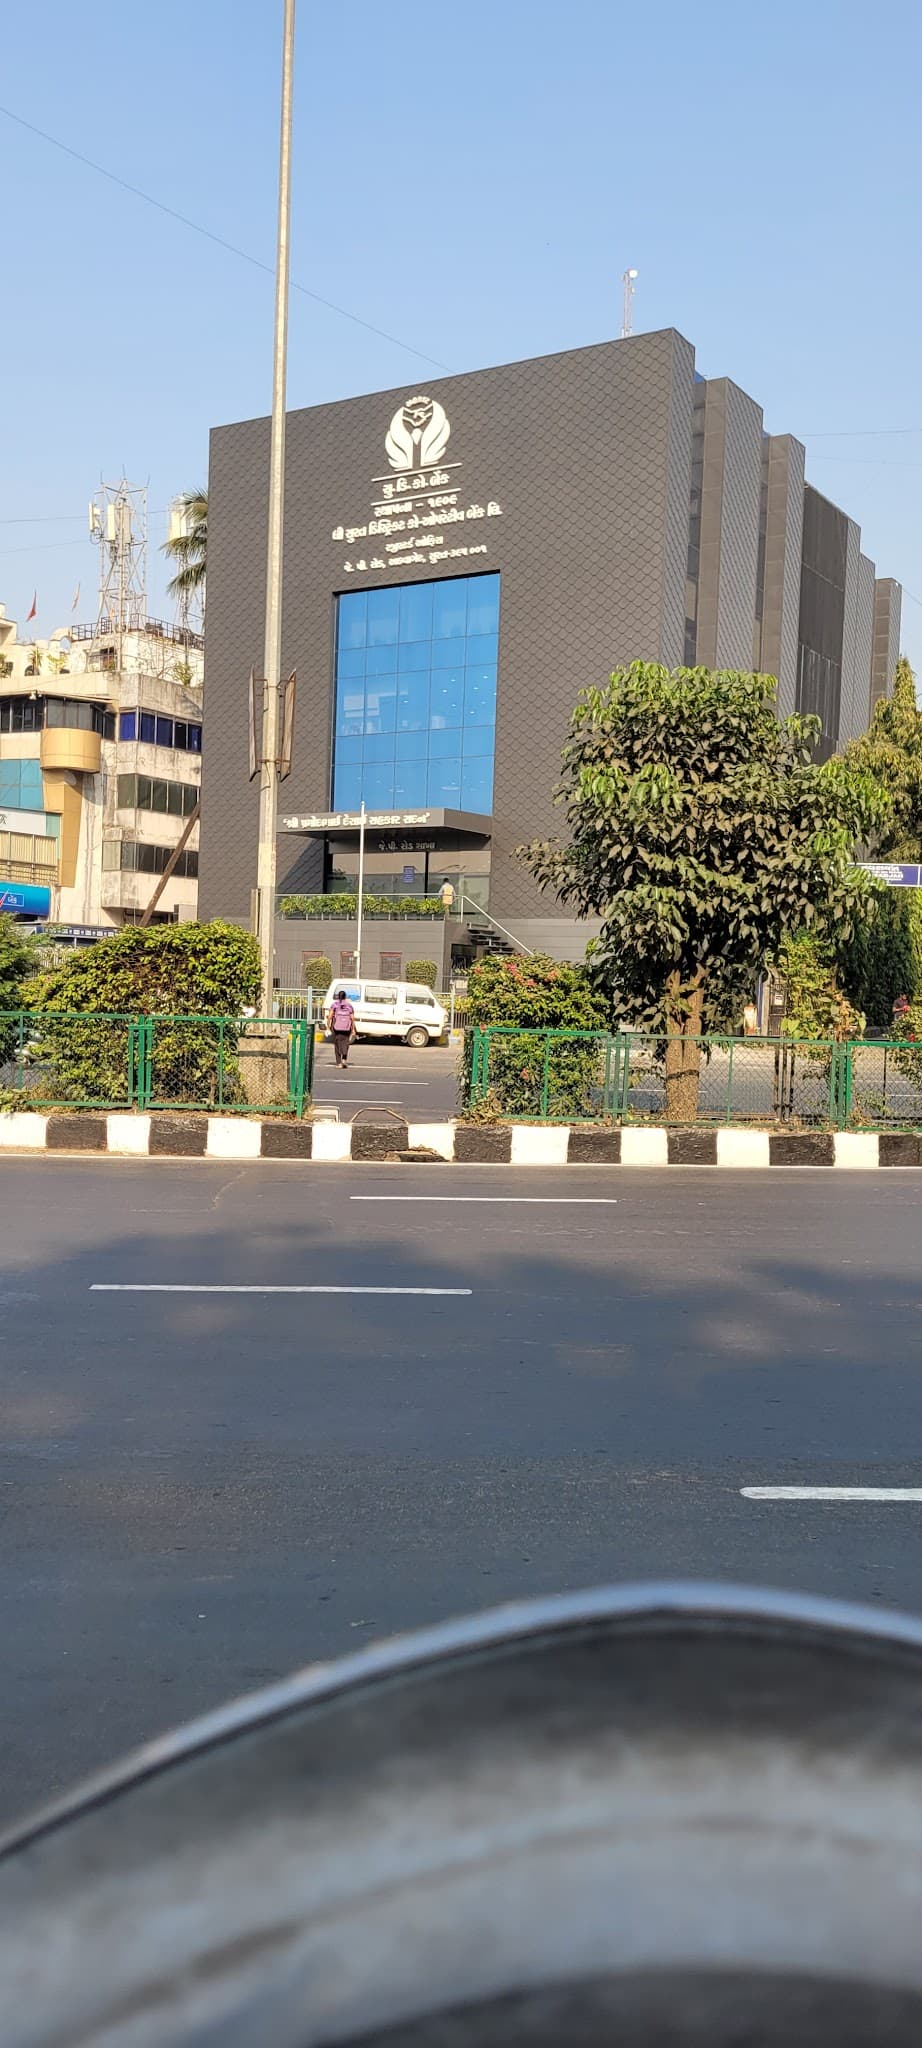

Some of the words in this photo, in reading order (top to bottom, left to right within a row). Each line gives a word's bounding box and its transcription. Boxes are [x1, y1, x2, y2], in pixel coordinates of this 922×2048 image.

[374, 501, 413, 517] સ્થાપના
[427, 494, 458, 508] ૧૯૦૯
[345, 526, 367, 543] સુરત
[466, 504, 486, 519] બેંક
